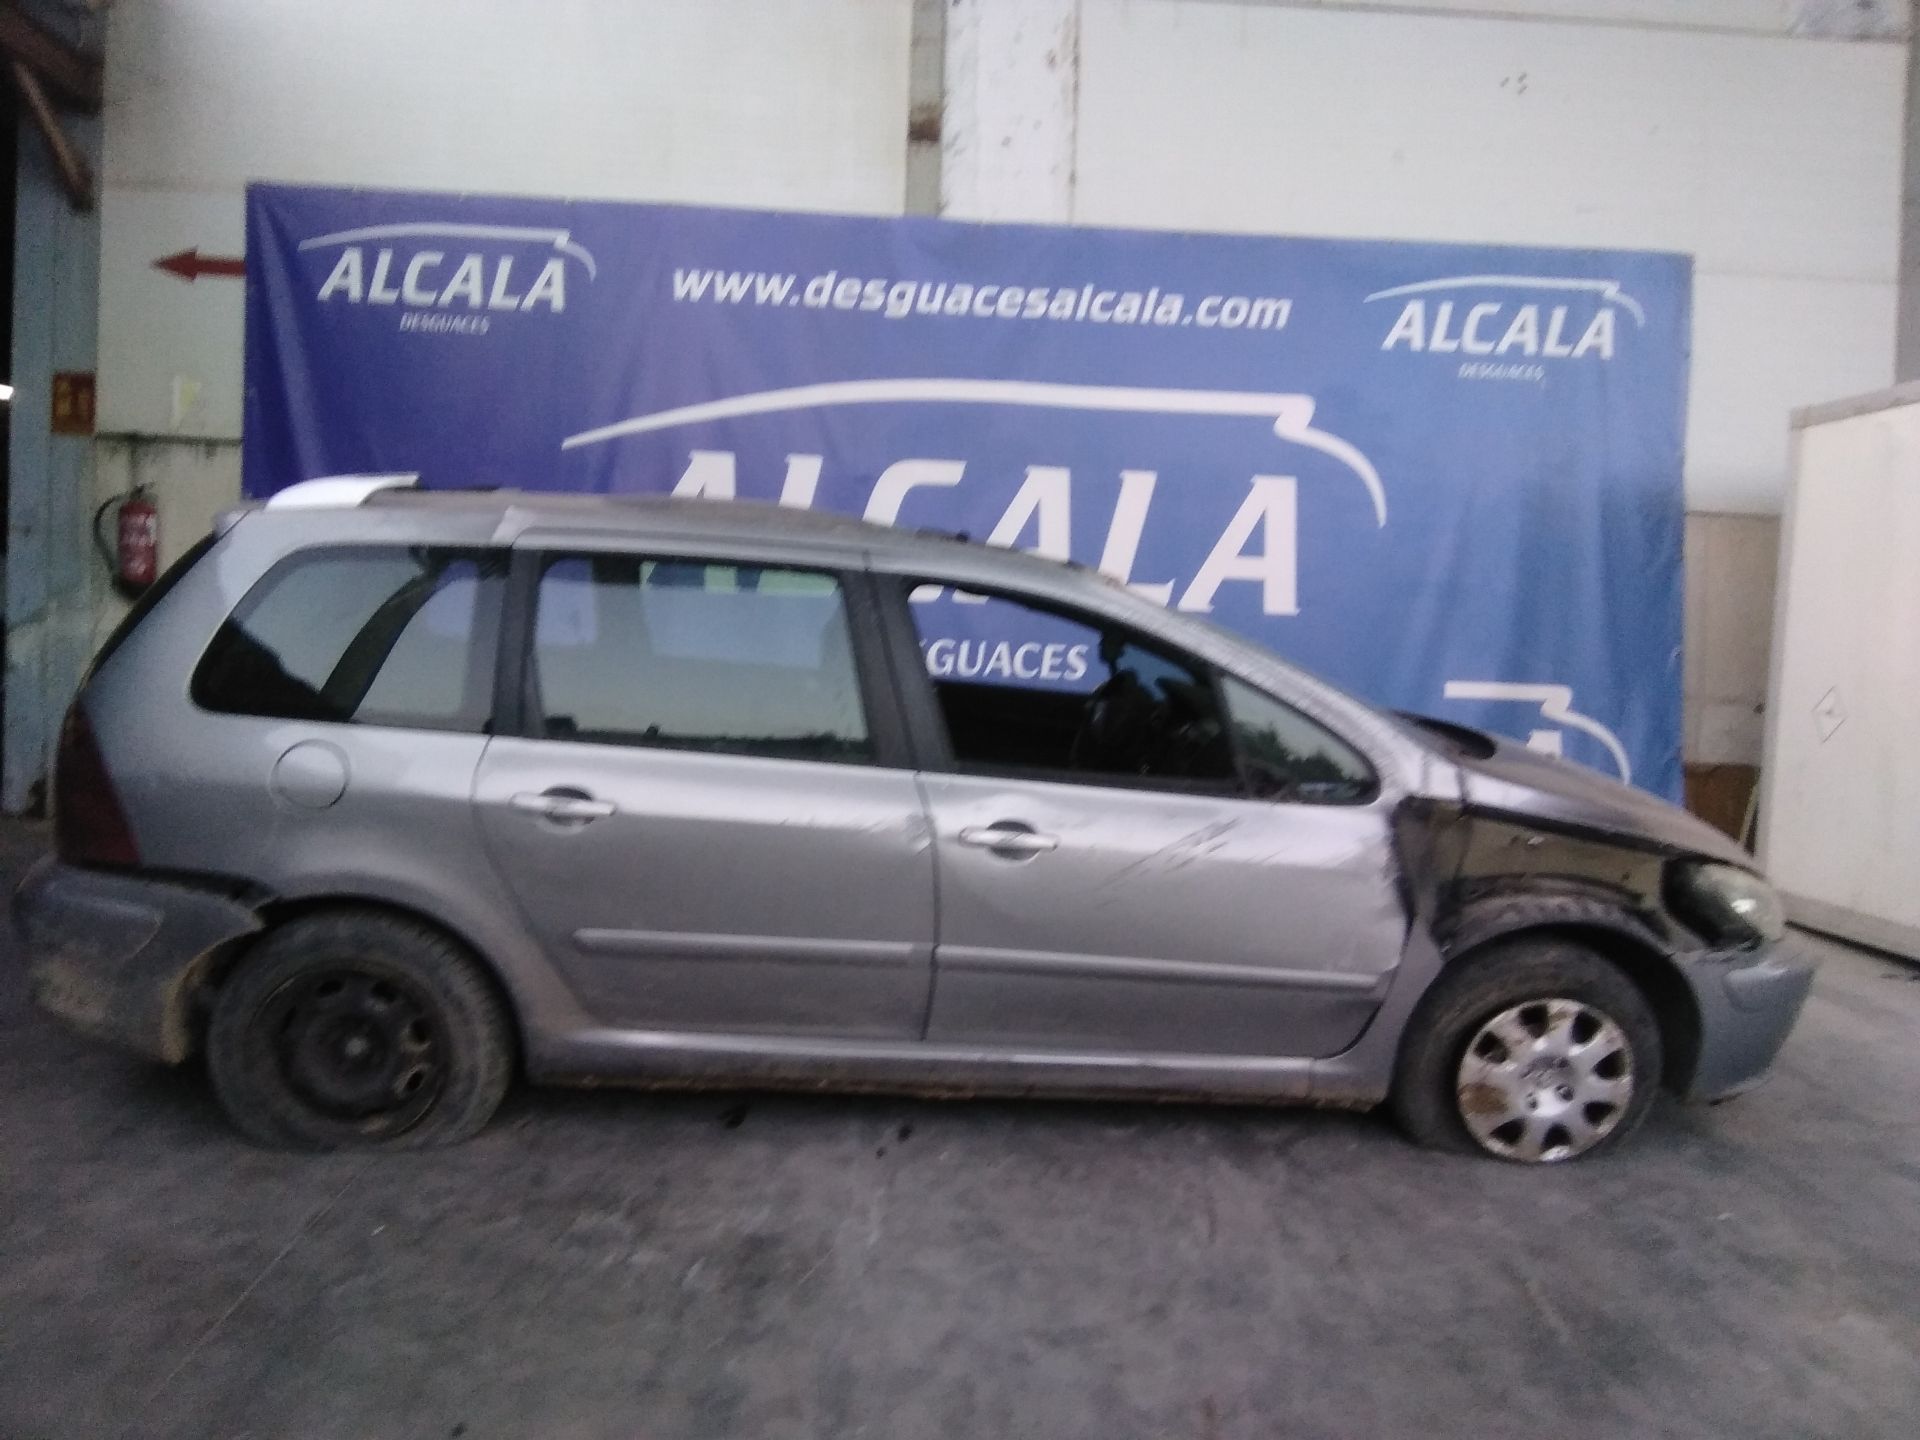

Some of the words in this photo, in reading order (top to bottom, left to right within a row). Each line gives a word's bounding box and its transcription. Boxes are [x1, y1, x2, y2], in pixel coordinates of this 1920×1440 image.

[317, 247, 566, 313] ALCALA
[672, 267, 1294, 331] www.desguacesalcala.com
[1381, 299, 1616, 360] ALCALA
[919, 637, 1090, 681] GUACES
